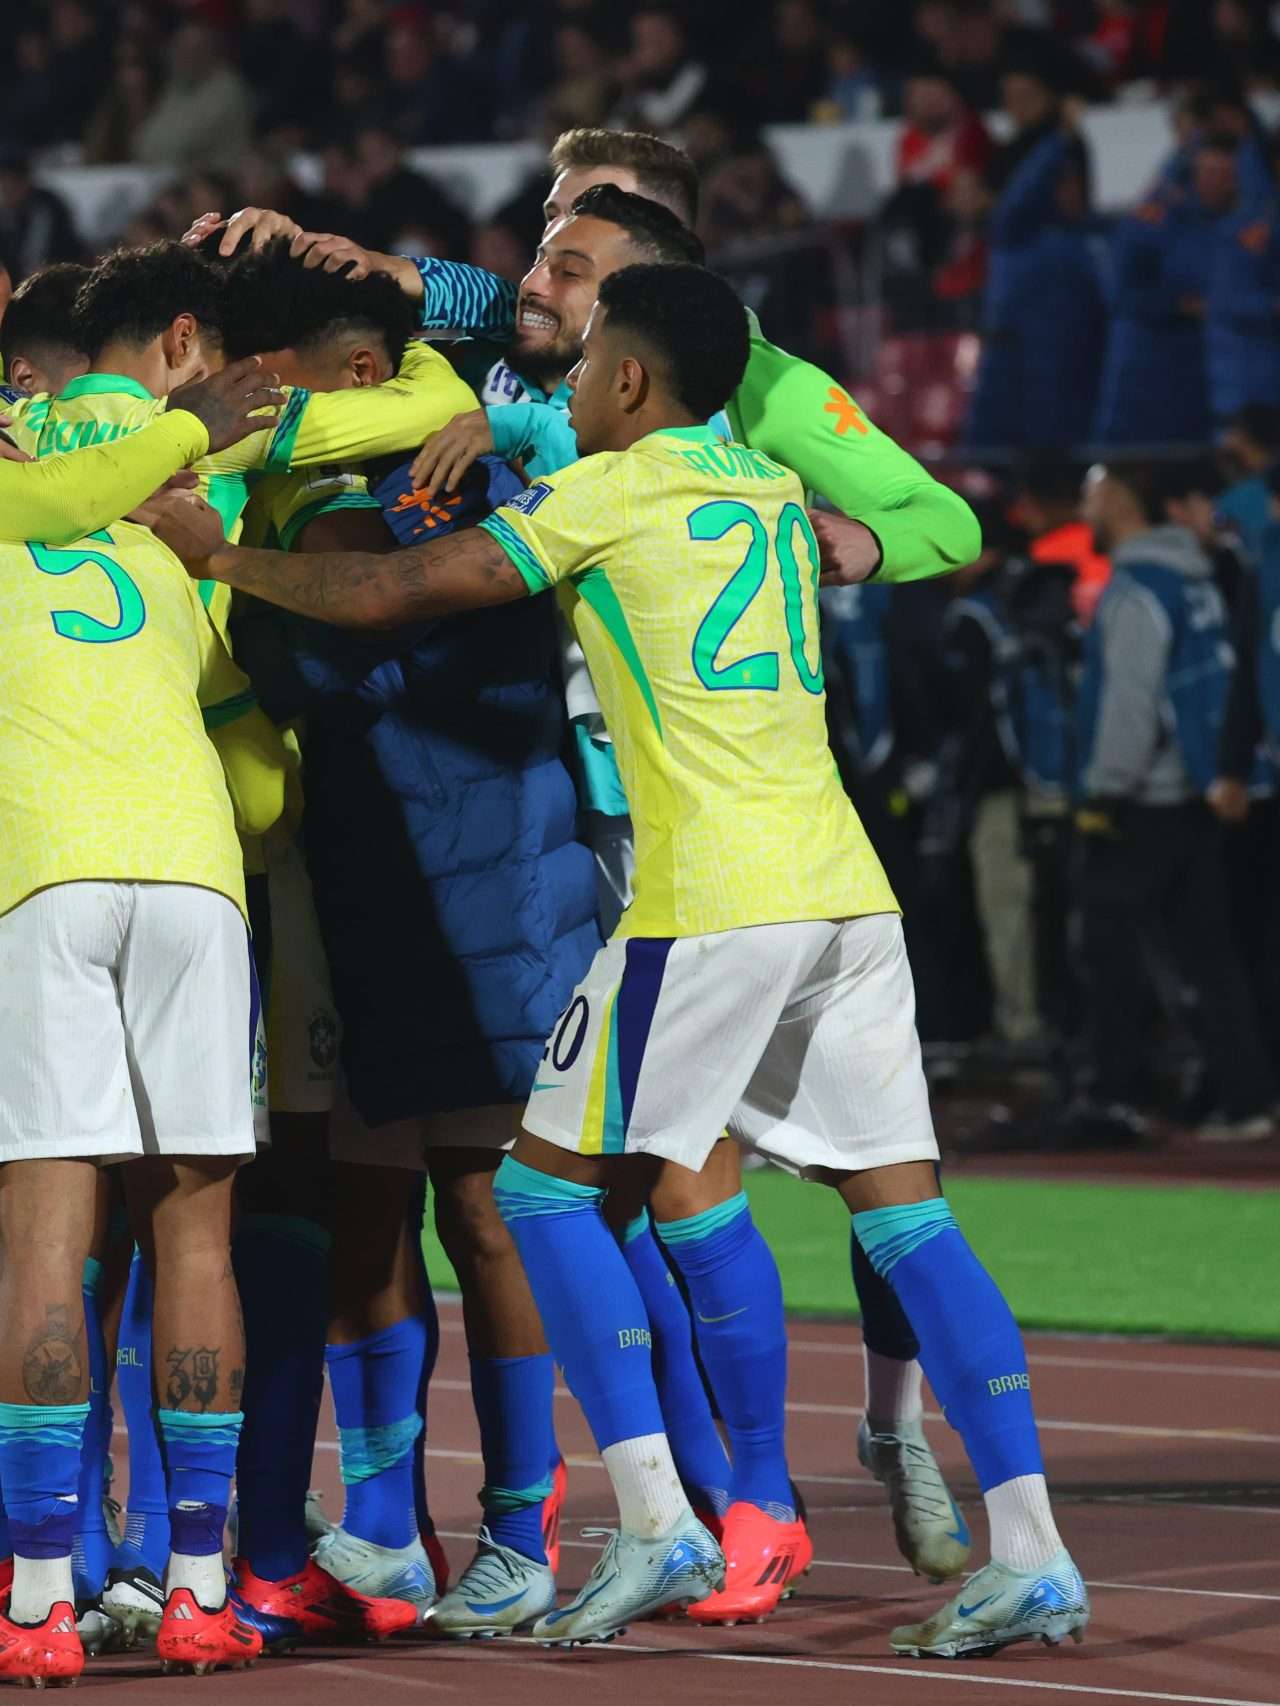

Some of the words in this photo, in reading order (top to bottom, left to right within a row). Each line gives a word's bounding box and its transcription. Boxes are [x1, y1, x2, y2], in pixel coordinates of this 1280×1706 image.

[24, 527, 146, 643] 5
[686, 500, 825, 695] 20
[543, 995, 590, 1072] 0
[117, 1347, 143, 1367] ASIL
[988, 1373, 1030, 1396] BRAS
